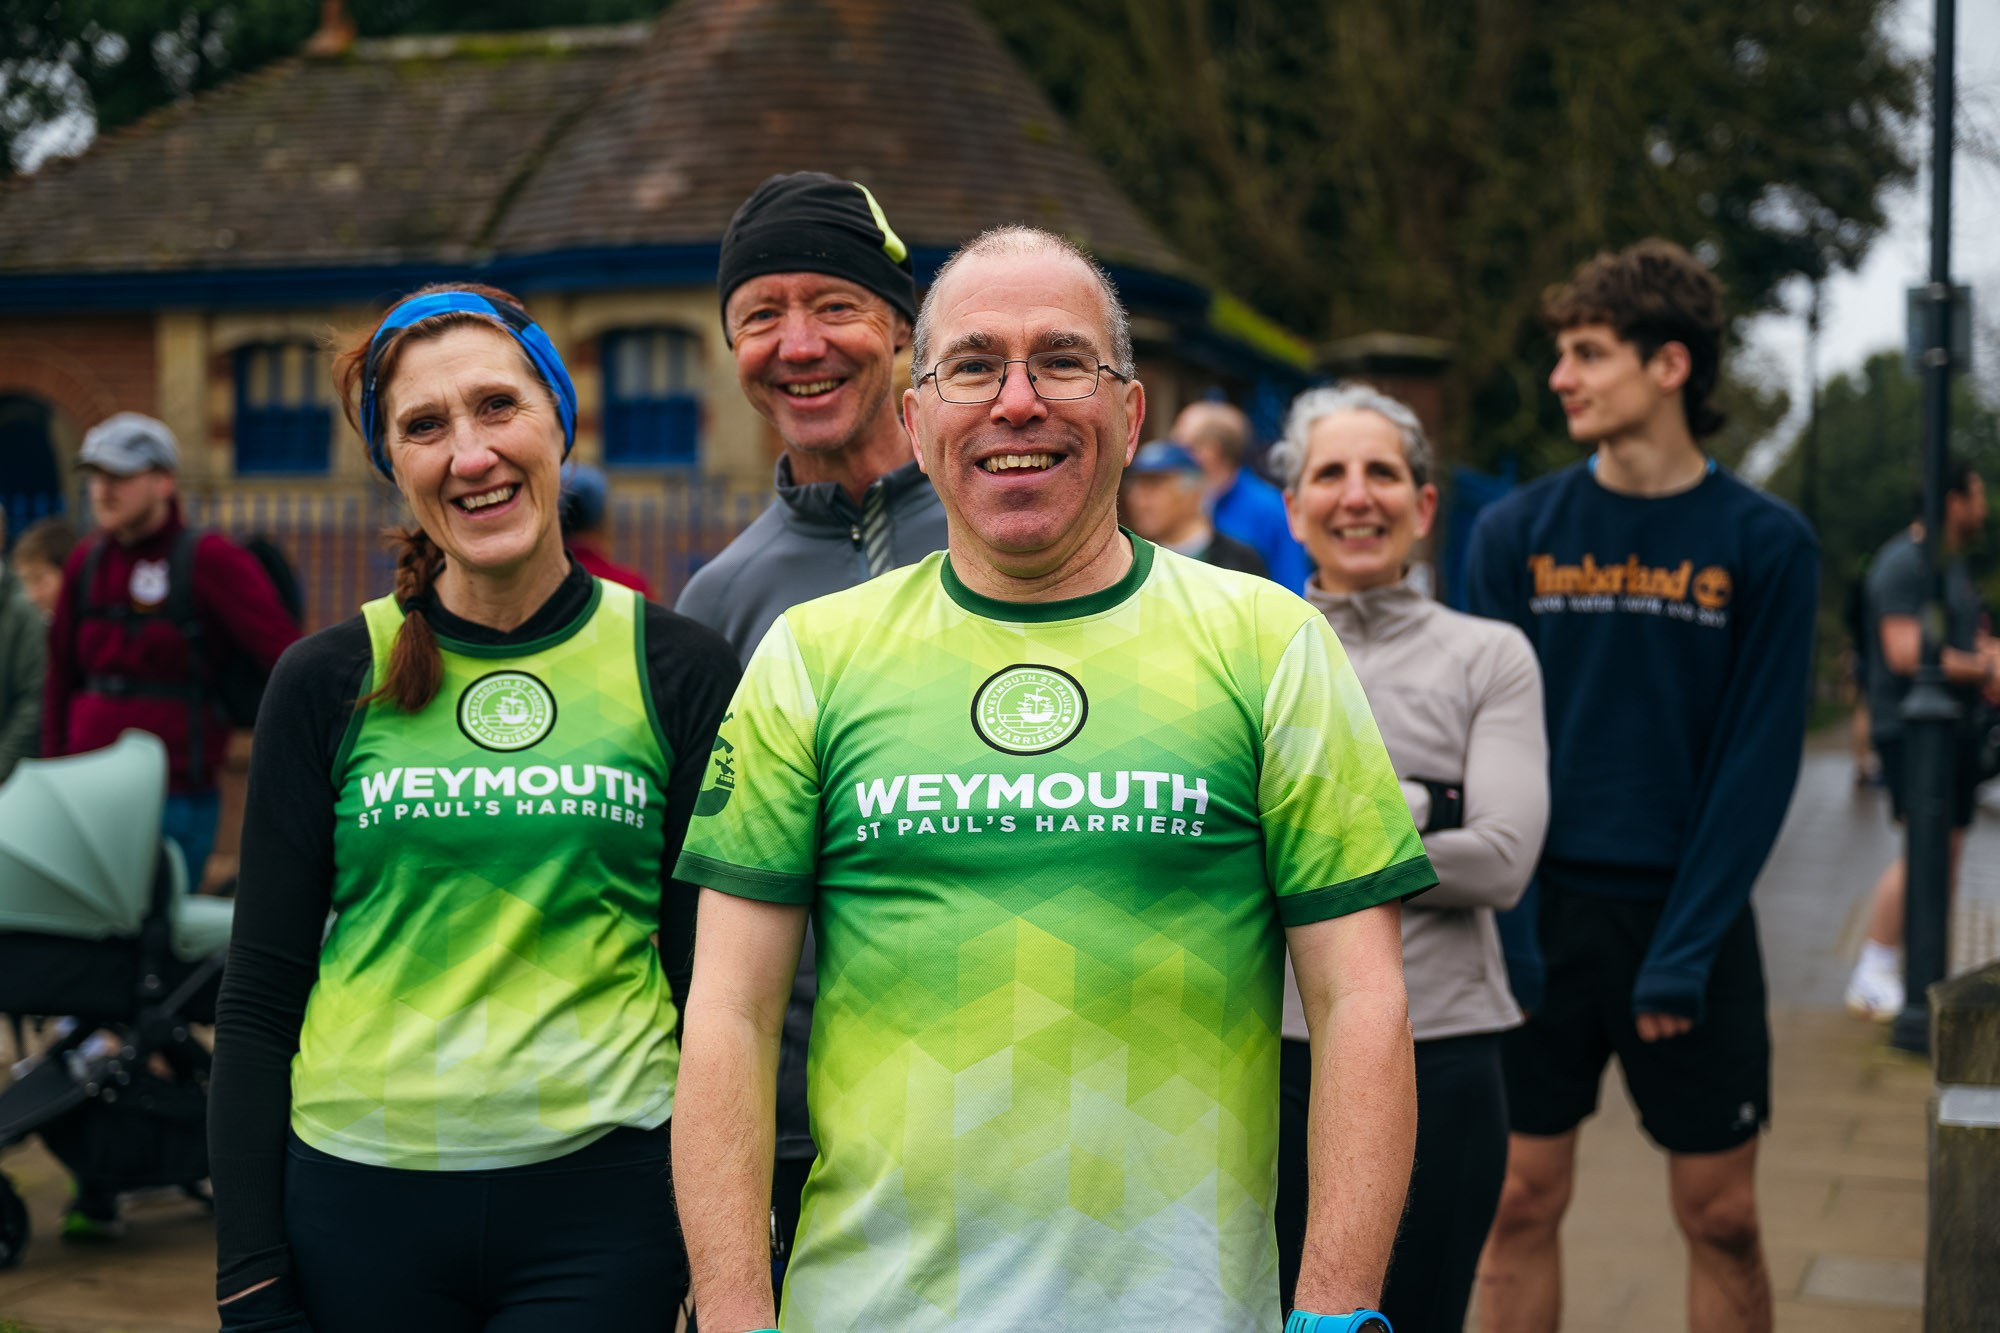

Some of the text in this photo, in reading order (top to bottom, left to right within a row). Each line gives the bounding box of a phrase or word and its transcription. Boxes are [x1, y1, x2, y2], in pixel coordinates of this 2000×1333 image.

[1527, 553, 1693, 600] Timberland
[470, 681, 511, 717] WEYMOUTH
[515, 681, 529, 689] ST
[987, 675, 1072, 715] WEYMOUTH ST PAUL'S
[477, 726, 538, 743] HARRIERS
[994, 725, 1064, 745] HARRIERS
[360, 764, 648, 809] WEYMOUTH
[855, 770, 1209, 818] WEYMOUTH
[358, 799, 645, 829] ST PAUL'S HARRIERS
[856, 814, 1205, 842] ST PAUL'S HARRIERS
